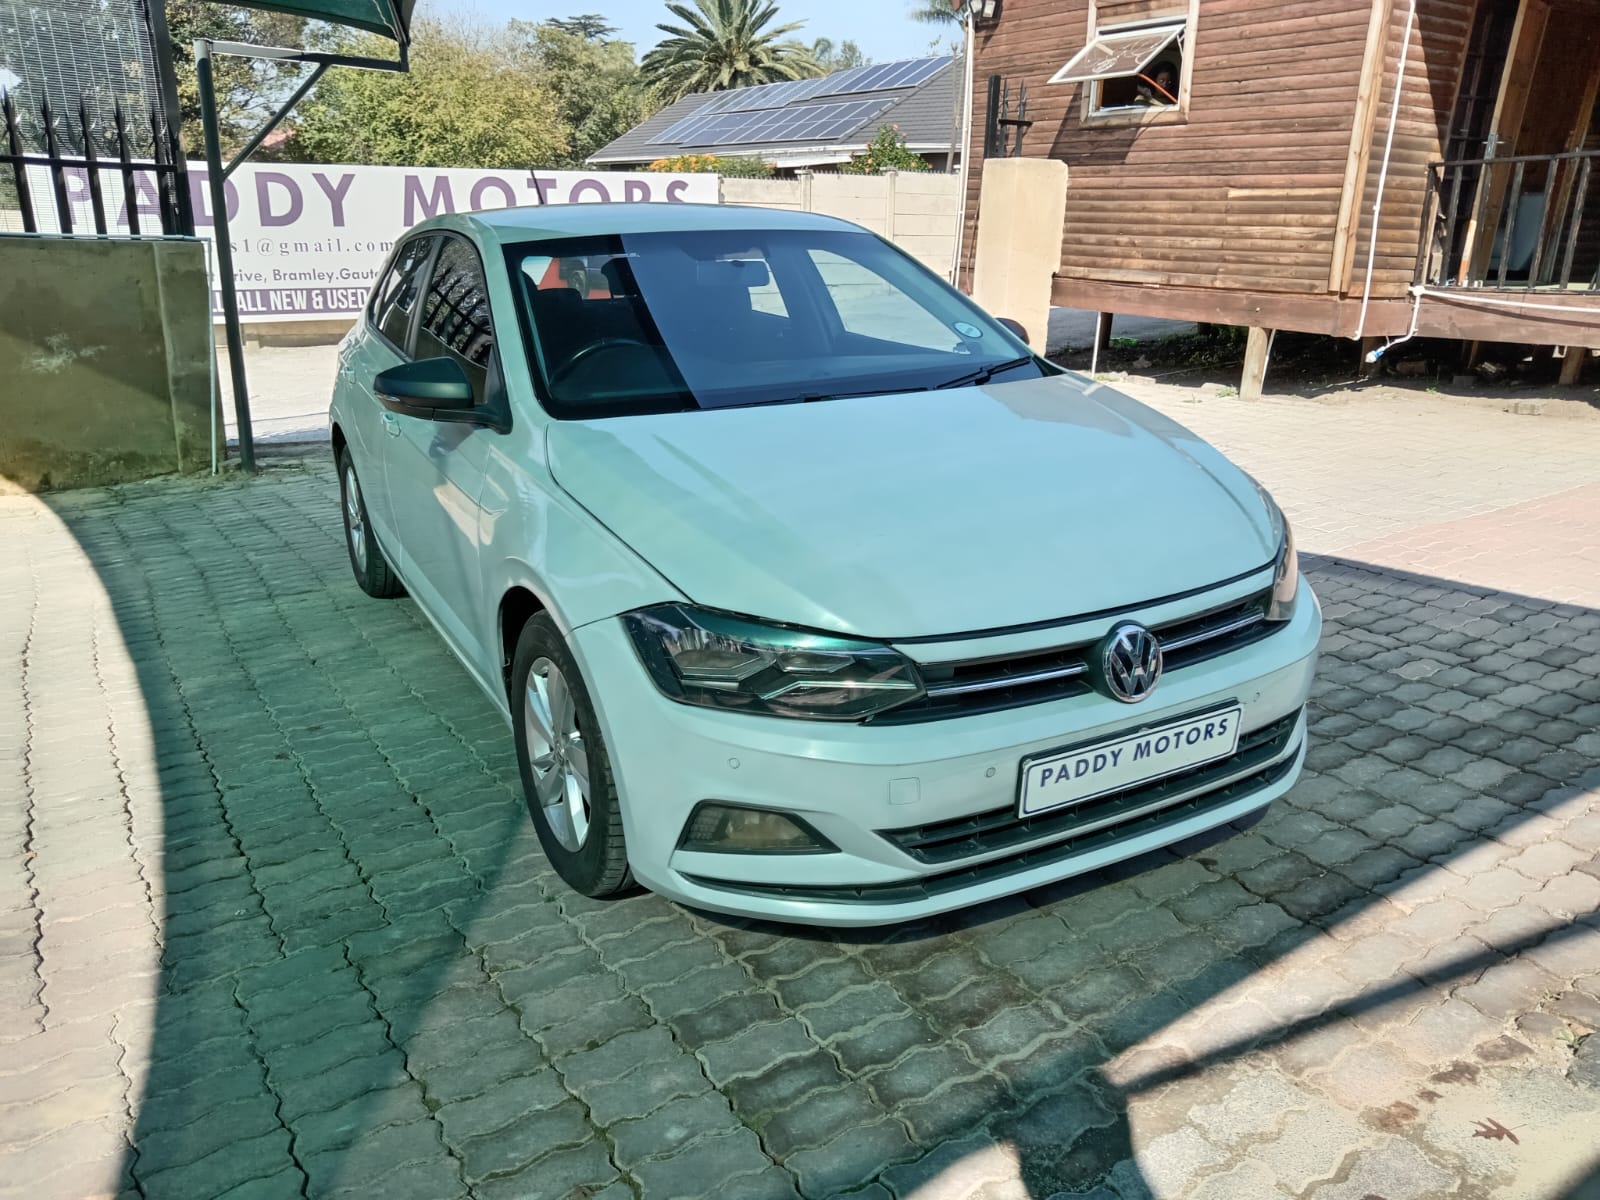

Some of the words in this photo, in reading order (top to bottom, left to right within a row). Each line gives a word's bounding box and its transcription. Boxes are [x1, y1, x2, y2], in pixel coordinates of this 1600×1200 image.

[61, 166, 356, 228] PADDY
[230, 238, 393, 256] s1@gmail.com
[233, 269, 267, 283] rive,
[237, 291, 267, 312] ALL
[270, 290, 307, 311] NEW
[312, 289, 324, 310] &
[327, 288, 368, 309] USED
[1040, 748, 1123, 788] PADDY
[1133, 718, 1228, 761] MOTORS
